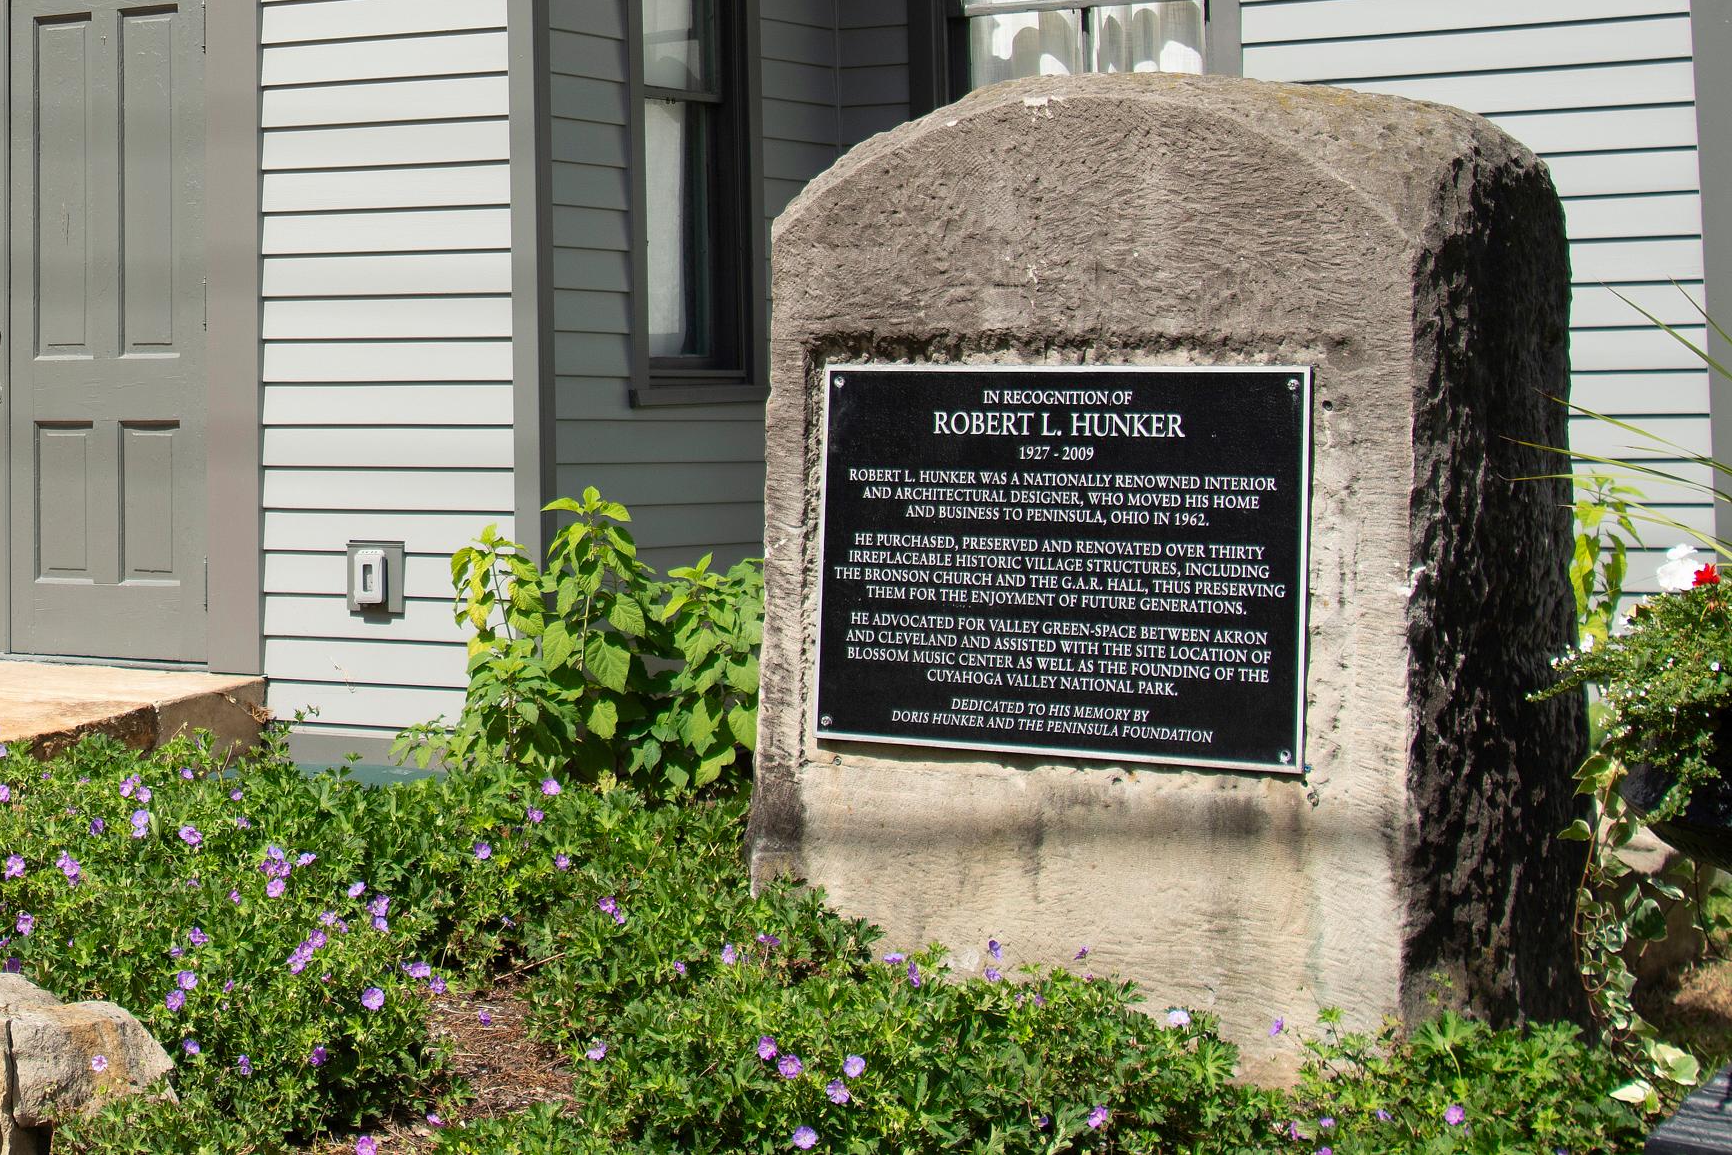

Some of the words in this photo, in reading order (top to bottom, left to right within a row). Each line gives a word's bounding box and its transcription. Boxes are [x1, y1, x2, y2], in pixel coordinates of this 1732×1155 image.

[983, 390, 1000, 403] IN
[1003, 390, 1108, 404] RECOGNITION
[1112, 390, 1132, 404] OF
[933, 411, 1034, 435] ROBERT
[1040, 412, 1061, 436] L.
[1070, 412, 1185, 437] HUNKER
[1019, 445, 1050, 459] 1927
[1061, 446, 1094, 460] 2009
[849, 468, 901, 481] ROBERT
[904, 469, 915, 482] L.
[919, 470, 976, 483] HUNKER
[979, 471, 1006, 484] WAS
[1010, 471, 1019, 484] A
[1023, 472, 1112, 487] NATIONALLY
[1114, 474, 1200, 488] RENOWNED
[1204, 476, 1277, 490] INTERIOR
[862, 485, 891, 498] AND
[894, 486, 1007, 502] ARCHITECTURAL
[1010, 490, 1083, 506] DESIGNER,
[1087, 492, 1123, 505] WHO
[1127, 492, 1181, 506] MOVED
[1185, 494, 1208, 507] HIS
[1213, 495, 1259, 508] HOME
[905, 504, 934, 517] AND
[938, 505, 999, 520] BUSINESS
[1002, 507, 1022, 520] TO
[1026, 508, 1106, 525] PENINSULA,
[1110, 510, 1149, 524] OHIO
[1153, 511, 1170, 524] IN
[1174, 512, 1208, 526] 1962.
[854, 532, 873, 545] HE
[876, 533, 958, 551] PURCHASED,
[962, 536, 1038, 551] PRESERVED
[1041, 539, 1072, 552] AND
[1075, 540, 1161, 555] RENOVATED
[1165, 543, 1205, 557] OVER
[1208, 544, 1264, 559] THIRTY
[849, 549, 952, 566] IRREPLACEABLE
[955, 553, 1021, 569] HISTORIC
[1024, 556, 1083, 571] VILLAGE
[1086, 558, 1180, 577] STRUCTURES,
[1185, 562, 1269, 578] INCLUDING
[834, 566, 861, 579] THE
[864, 567, 929, 582] BRONSON
[932, 570, 992, 585] CHURCH
[995, 573, 1025, 586] AND
[1029, 574, 1058, 588] THE
[1061, 576, 1102, 590] G.A.R.
[1106, 577, 1148, 594] HALL,
[1152, 579, 1190, 594] THUS
[1194, 581, 1285, 597] PRESERVING
[865, 585, 905, 599] THEM
[909, 587, 936, 600] FOR
[939, 588, 967, 602] THE
[971, 590, 1055, 606] ENJOYMENT
[1058, 593, 1077, 607] OF
[1081, 594, 1136, 609] FUTURE
[1139, 597, 1246, 614] GENERATIONS.
[850, 611, 869, 624] HE
[872, 613, 954, 629] ADVOCATED
[957, 617, 985, 630] FOR
[988, 618, 1039, 633] VALLEY
[1042, 621, 1136, 638] GREEN-SPACE
[1140, 626, 1210, 642] BETWEEN
[1213, 629, 1267, 644] AKRON
[845, 629, 874, 642] AND
[878, 630, 957, 646] CLEVELAND
[960, 635, 990, 648] AND
[993, 636, 1056, 652] ASSISTED
[1059, 640, 1099, 654] WITH
[1102, 642, 1132, 656] THE
[1135, 643, 1166, 658] SITE
[1169, 645, 1247, 662] LOCATION
[1251, 650, 1271, 664] OF
[847, 646, 909, 661] BLOSSOM
[912, 650, 955, 664] MUSIC
[958, 652, 1013, 668] CENTER
[1016, 655, 1032, 669] AS
[1035, 656, 1074, 671] WELL
[1077, 659, 1093, 672] AS
[1097, 660, 1127, 674] THE
[1130, 662, 1210, 679] FOUNDING
[1214, 666, 1234, 680] OF
[1237, 667, 1269, 683] THE
[926, 668, 1002, 685] CUYAHOGA
[1006, 673, 1057, 688] VALLEY
[1059, 676, 1134, 693] NATIONAL
[1137, 680, 1177, 696] PARK.
[950, 698, 1024, 713] DEDICATED
[1027, 702, 1045, 715] TO
[1048, 704, 1070, 716] HIS
[1072, 705, 1131, 720] MEMORY
[1132, 709, 1149, 722] BY
[891, 710, 929, 723] DORIS
[931, 712, 984, 727] HUNKER
[985, 716, 1014, 729] AND
[1017, 718, 1044, 731] THE
[1046, 720, 1118, 736] PENINSULA
[1121, 725, 1213, 743] FOUNDATION
